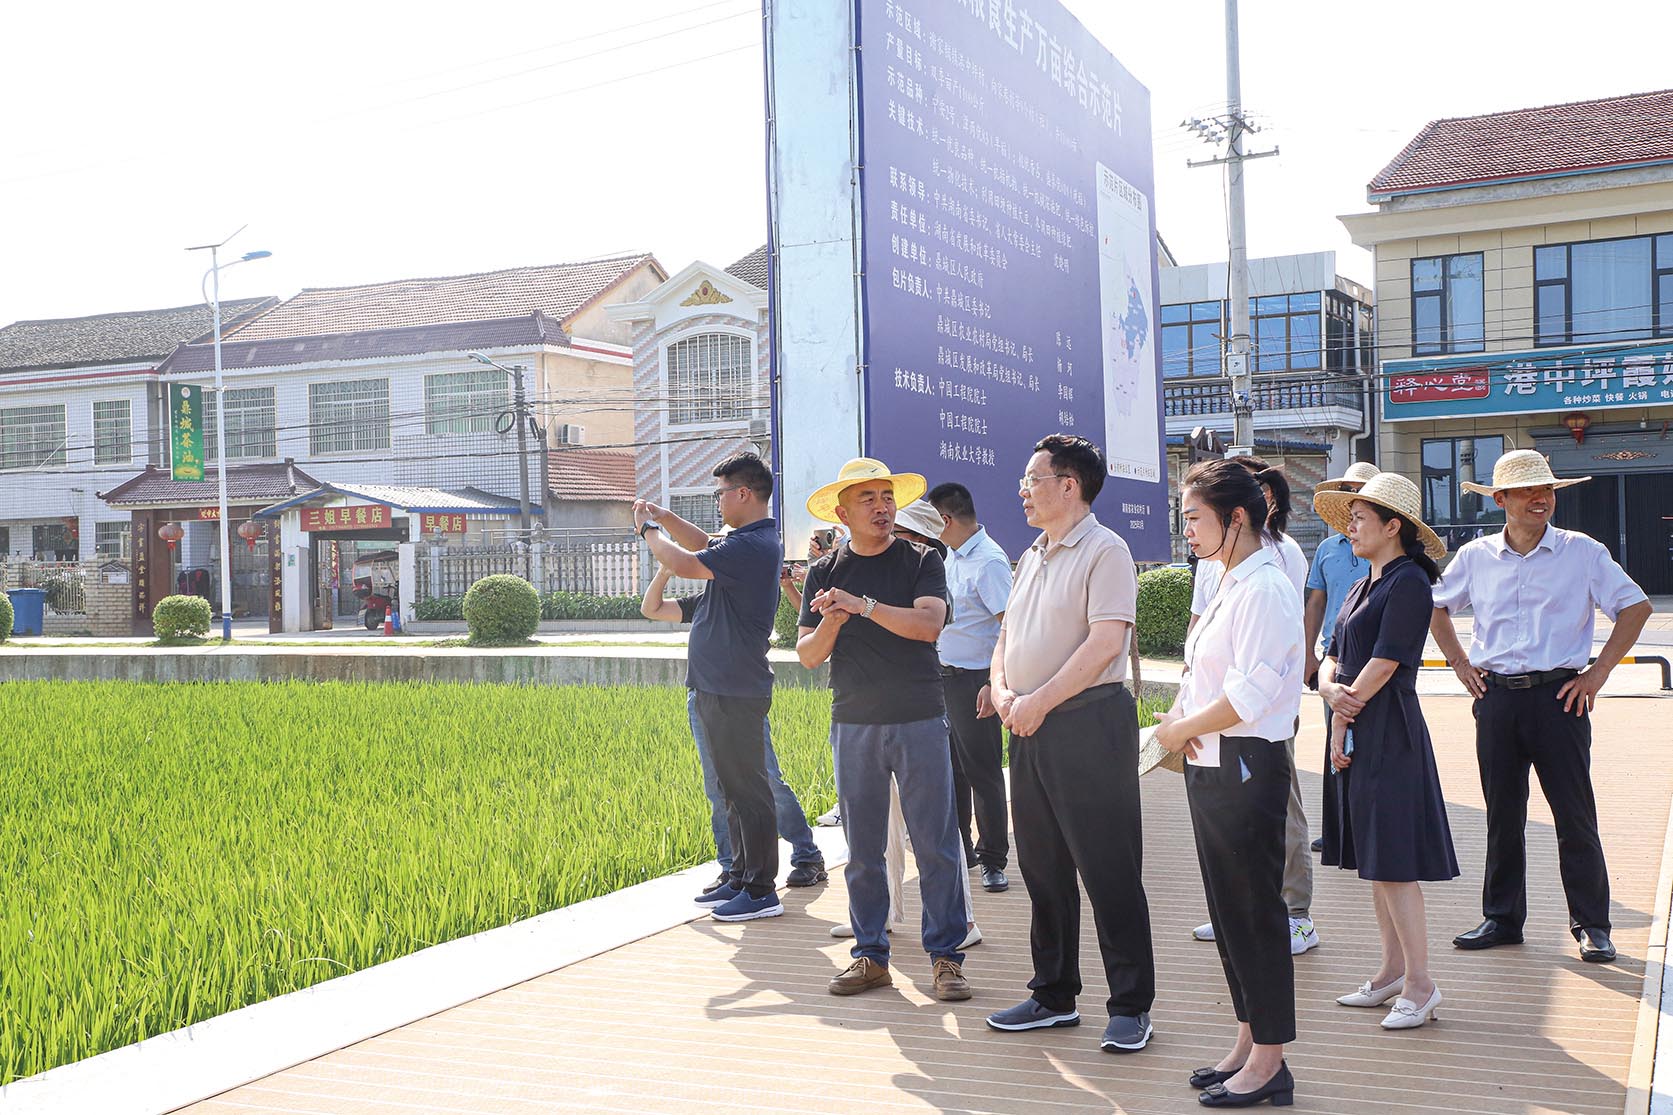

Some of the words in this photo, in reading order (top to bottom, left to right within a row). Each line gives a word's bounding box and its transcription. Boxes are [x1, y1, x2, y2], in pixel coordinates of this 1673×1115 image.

[1563, 393, 1601, 405] 各种炒菜
[1605, 392, 1624, 402] 快餐
[1628, 391, 1648, 401] 火锅
[939, 409, 988, 436] 中国工程院院士
[939, 440, 996, 467] 湖南农业大学教授
[309, 507, 382, 525] 三姐早餐店
[425, 515, 462, 532] 早餐店
